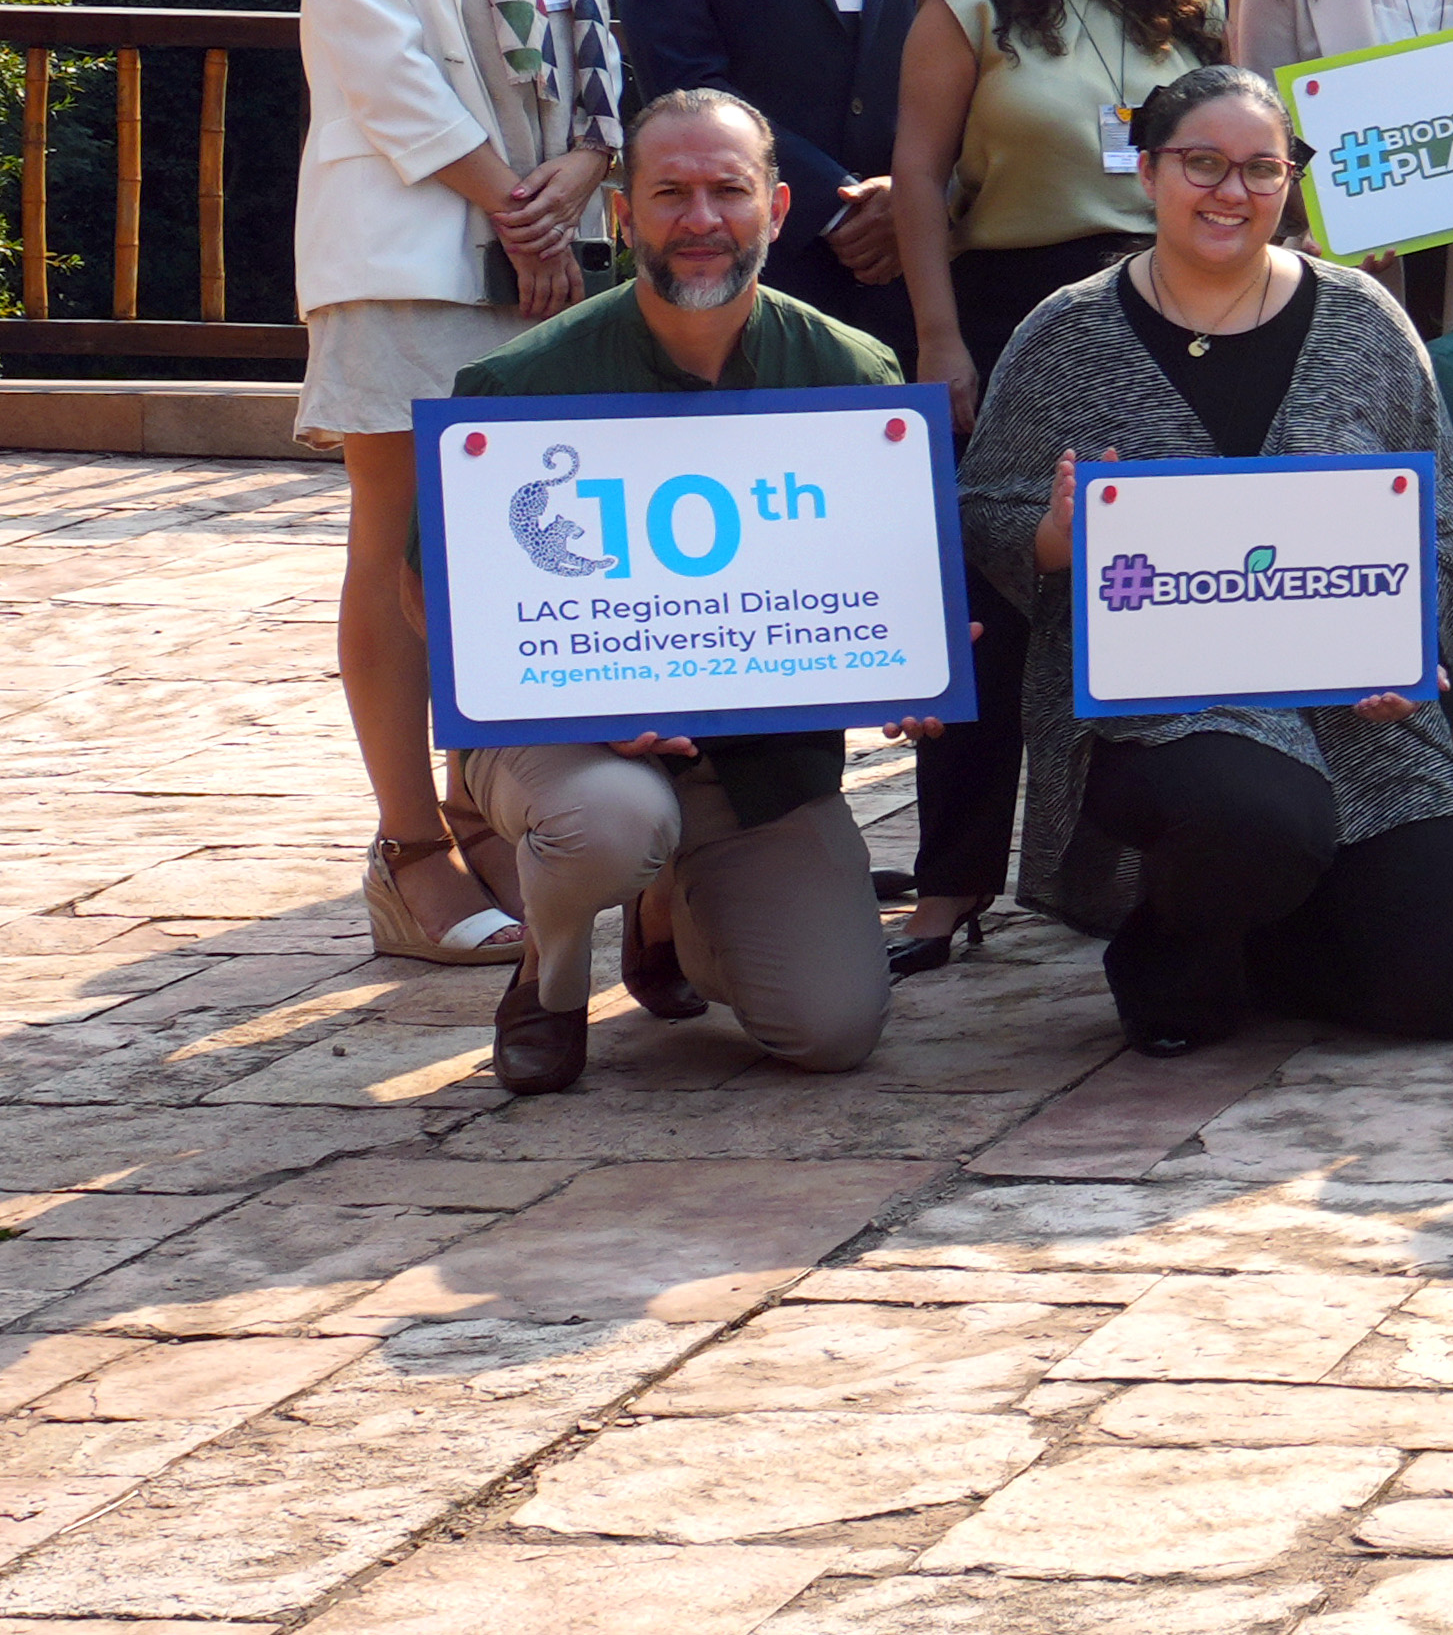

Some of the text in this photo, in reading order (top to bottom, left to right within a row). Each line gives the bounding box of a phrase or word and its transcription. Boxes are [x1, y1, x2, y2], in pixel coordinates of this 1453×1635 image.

[576, 472, 827, 579] 10th
[1101, 554, 1408, 611] #BIODIVERSITY
[517, 588, 880, 627] LAC Regional Dialogue
[519, 620, 889, 657] on Biodiversity Finance
[520, 649, 907, 687] Argentina, 20-22 August 2024
